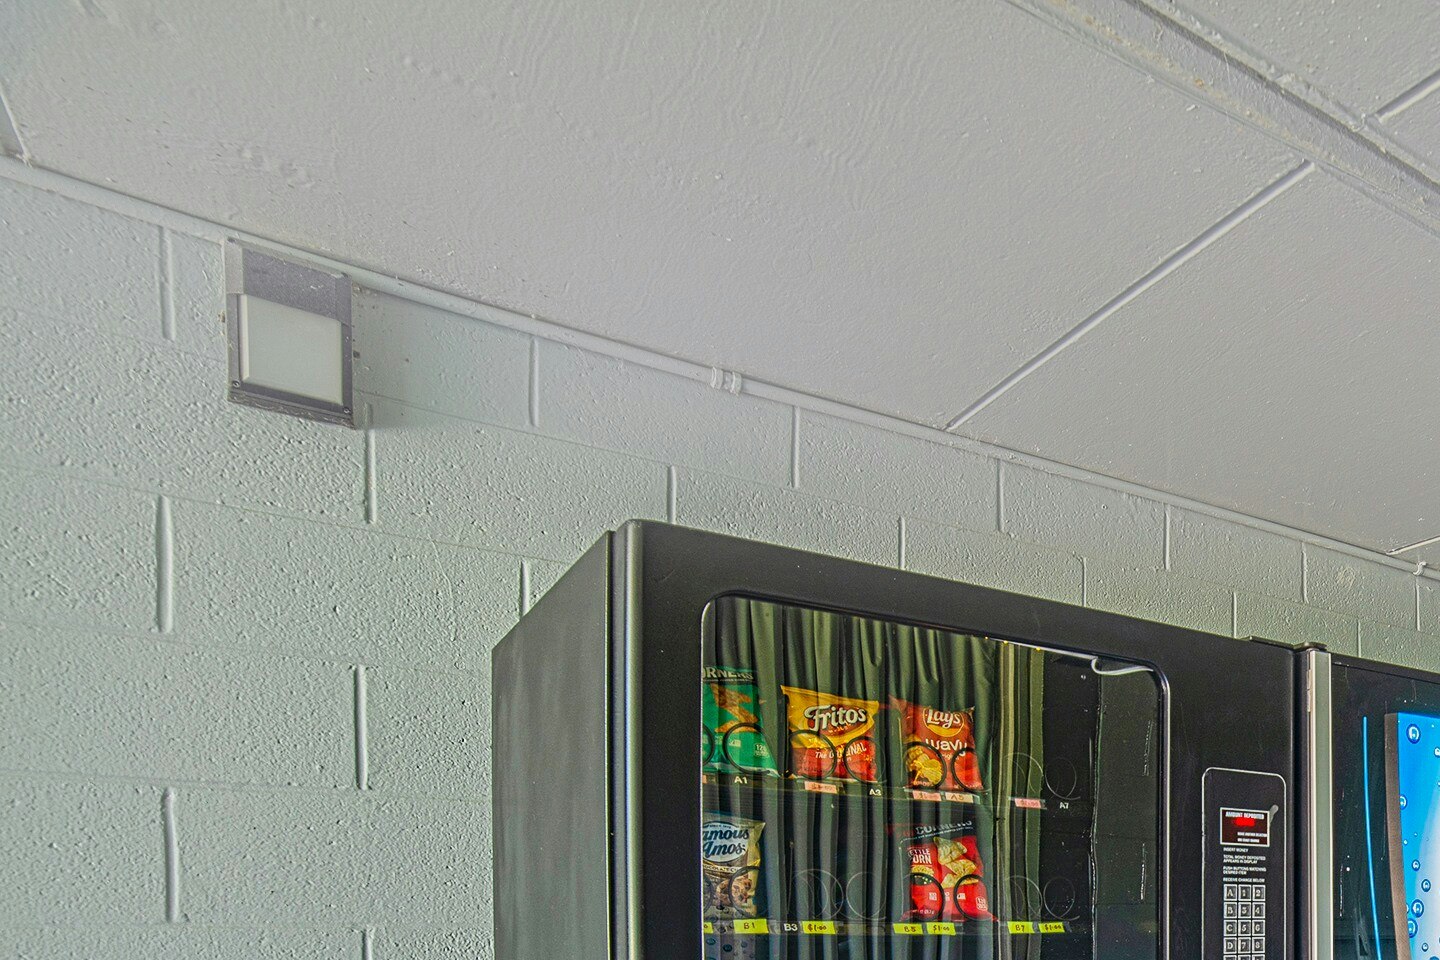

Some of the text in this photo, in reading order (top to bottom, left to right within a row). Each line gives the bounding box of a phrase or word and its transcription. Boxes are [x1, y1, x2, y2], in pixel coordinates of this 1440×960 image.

[804, 705, 867, 732] Fritos
[734, 776, 748, 784] A1
[1059, 802, 1069, 810] A7
[1227, 889, 1234, 897] A
[783, 923, 798, 931] B3
[1226, 924, 1233, 932] C
[1241, 924, 1247, 932] 5
[1227, 941, 1234, 950] D
[1241, 941, 1247, 949] 7
